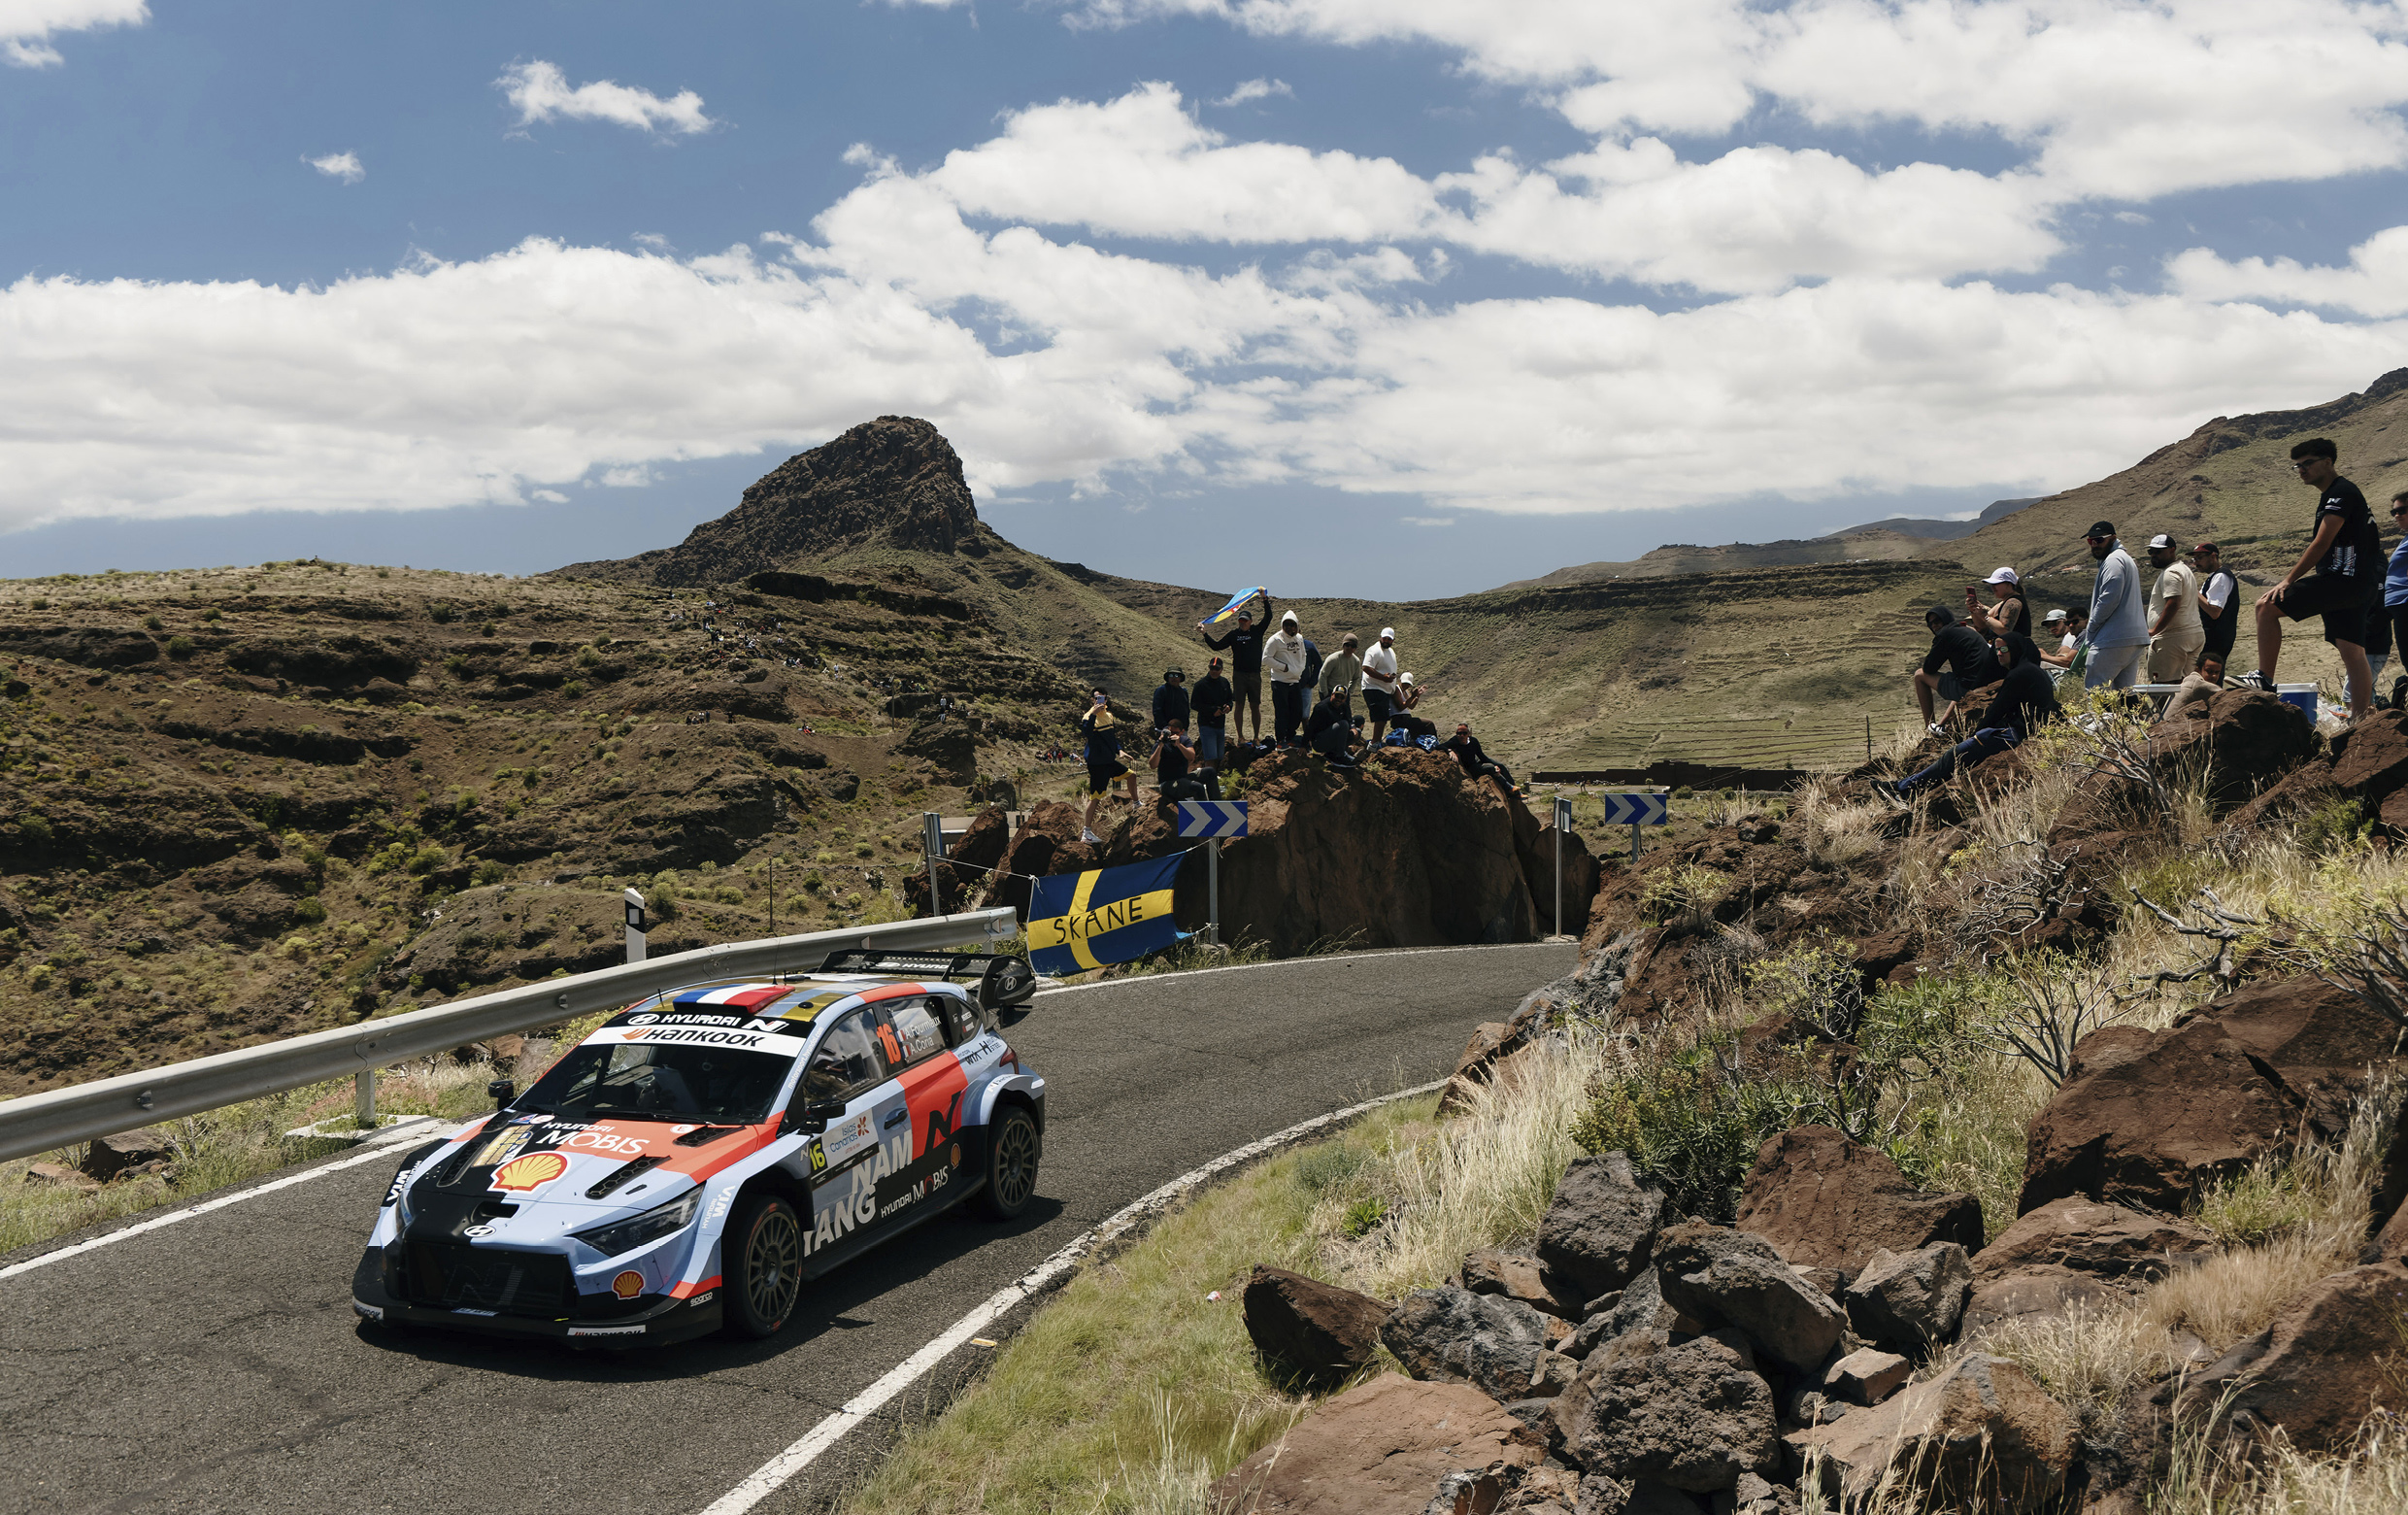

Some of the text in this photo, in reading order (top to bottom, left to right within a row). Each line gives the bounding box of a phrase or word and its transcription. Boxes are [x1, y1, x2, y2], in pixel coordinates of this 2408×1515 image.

[1054, 896, 1143, 944] SKÅNE
[661, 1014, 789, 1033] HYUNDAI N
[876, 1023, 902, 1064] 16
[542, 1121, 616, 1132] HYUNDAI
[841, 1123, 856, 1137] Islas
[536, 1129, 650, 1154] MOBIS
[829, 1131, 859, 1153] Canarias
[809, 1143, 826, 1171] 16
[852, 1129, 913, 1195] NAM
[881, 1165, 949, 1218] HYUNDAI MOBIS
[701, 1197, 718, 1229] HYUNDAI
[690, 1292, 714, 1305] sparco
